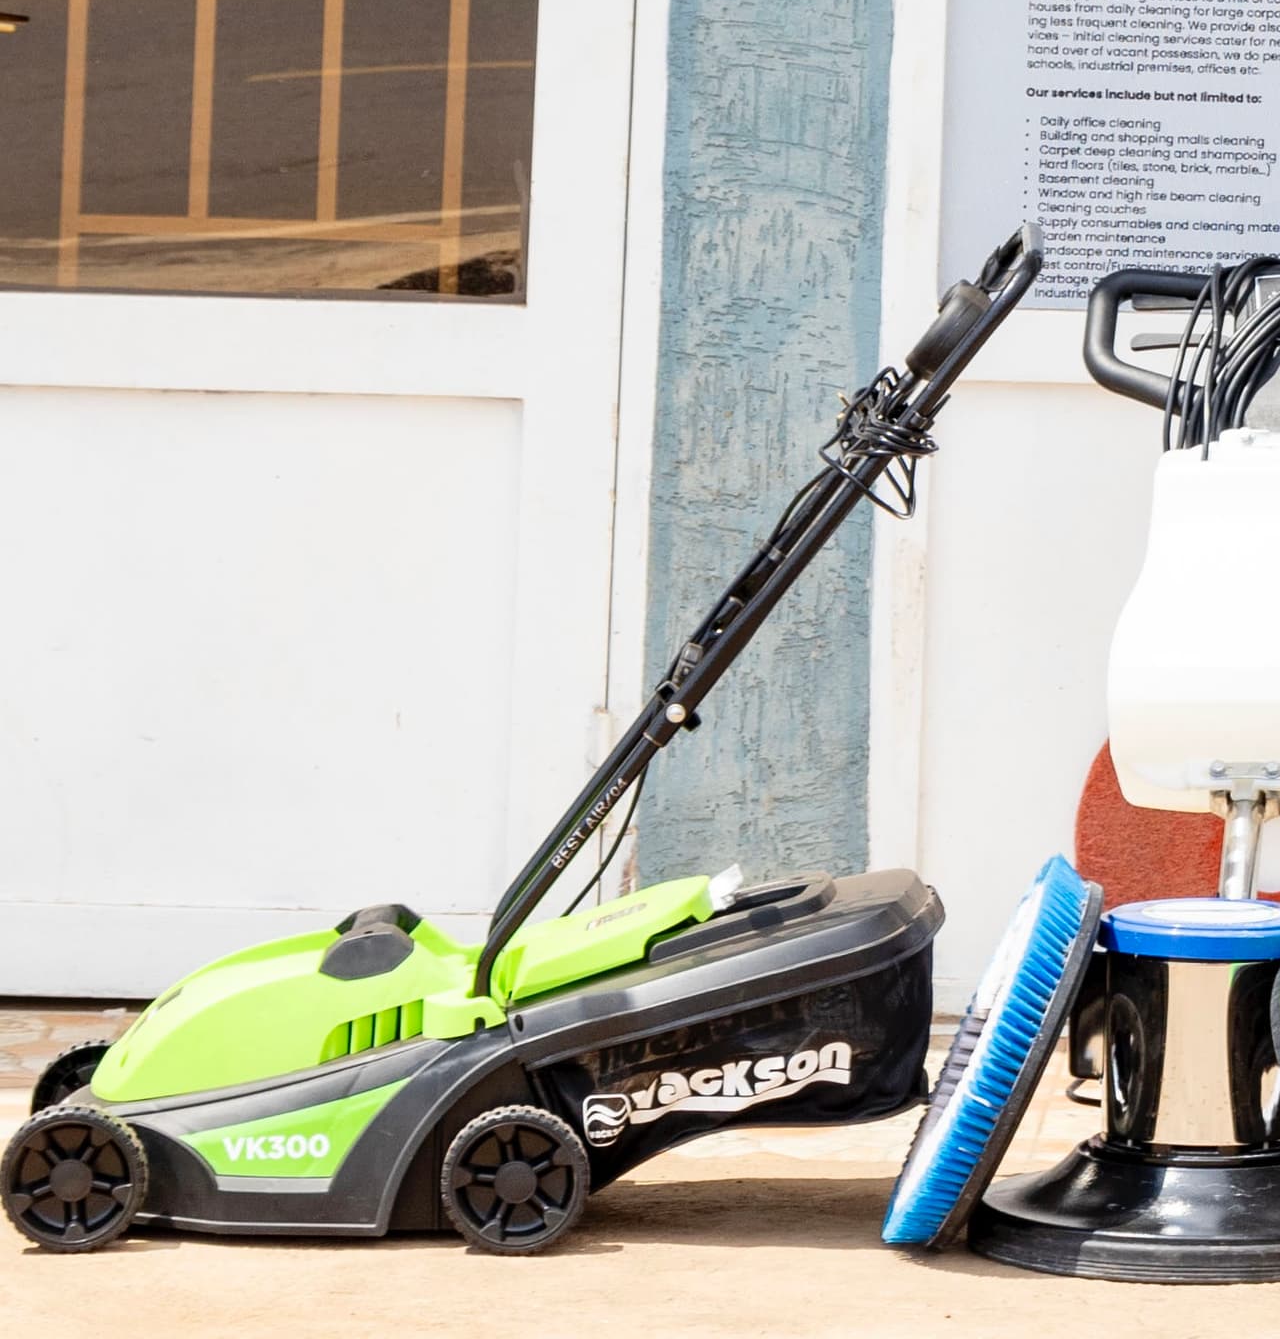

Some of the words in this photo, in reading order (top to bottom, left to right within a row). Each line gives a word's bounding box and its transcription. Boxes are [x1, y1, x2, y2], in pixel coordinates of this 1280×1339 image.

[1025, 87, 1049, 98] Our
[1051, 87, 1103, 100] services
[1105, 88, 1152, 101] include
[1153, 90, 1175, 101] but
[1176, 91, 1198, 102] not
[1200, 91, 1244, 104] limited
[1245, 93, 1262, 104] to:
[551, 827, 586, 869] BEST
[222, 1133, 330, 1162] VK300
